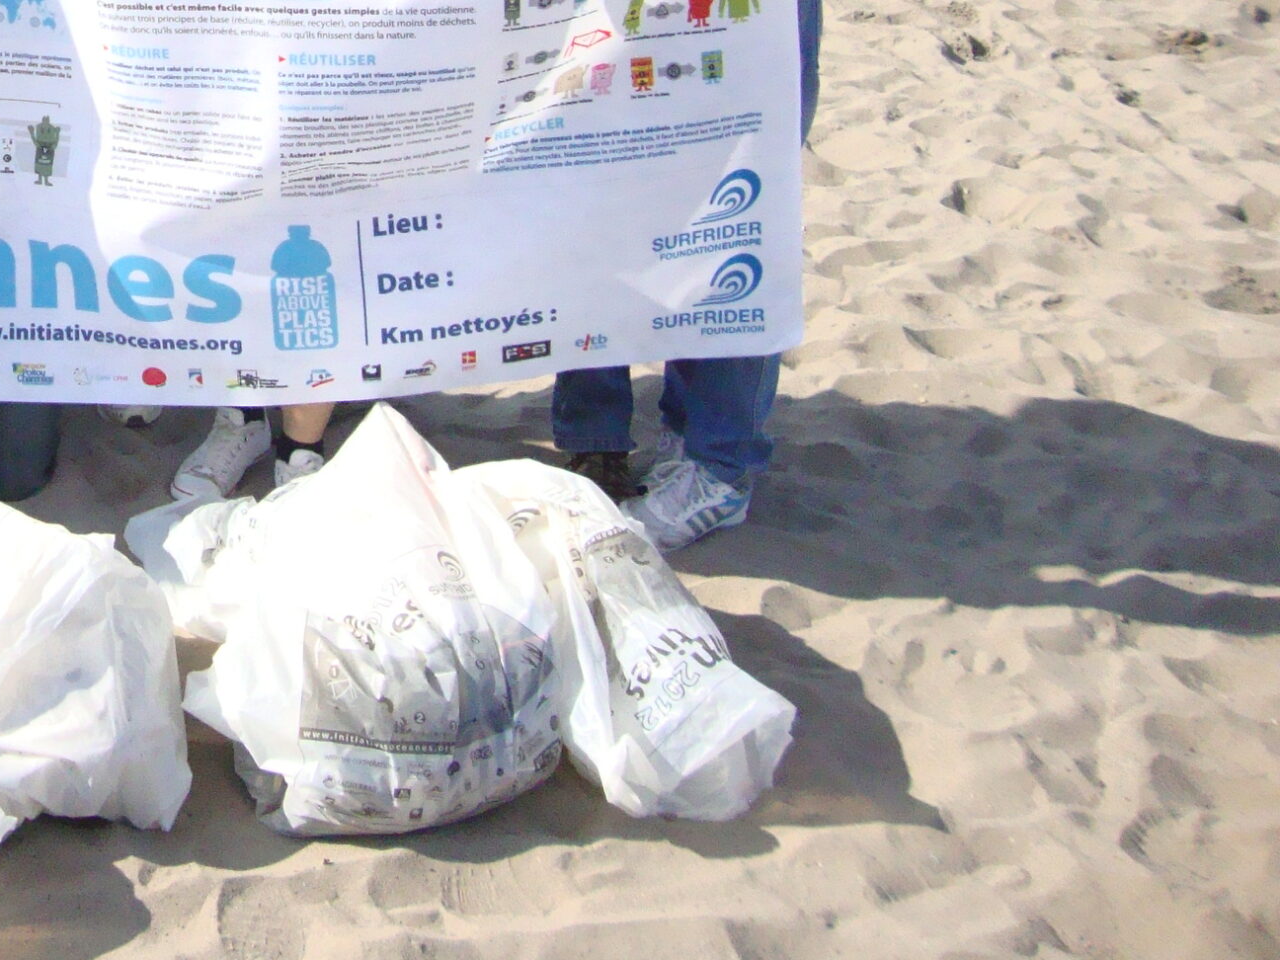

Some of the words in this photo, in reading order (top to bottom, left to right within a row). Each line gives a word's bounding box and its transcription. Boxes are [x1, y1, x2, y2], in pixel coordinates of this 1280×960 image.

[116, 2, 152, 12] possible
[166, 3, 186, 12] c'est
[188, 3, 215, 12] même
[217, 3, 242, 12] facile
[266, 6, 309, 16] quelques
[311, 8, 341, 17] gestes
[343, 8, 380, 18] simples
[382, 8, 393, 16] de
[405, 7, 418, 15] vie
[420, 5, 476, 17] quotidienne.
[137, 14, 155, 23] trois
[157, 15, 195, 26] principes
[198, 15, 207, 24] de
[210, 15, 230, 25] base
[362, 19, 394, 29] produit
[397, 19, 424, 28] moins
[426, 18, 438, 27] de
[440, 17, 476, 27] déchets.
[129, 25, 150, 34] donc
[174, 26, 199, 35] soient
[293, 31, 315, 42] qu'ils
[317, 30, 353, 40] finissent
[355, 30, 374, 40] dans
[376, 30, 384, 39] la
[386, 31, 417, 40] nature.
[111, 45, 170, 60] RÉDUIRE
[289, 52, 376, 66] RÉUTILISER
[371, 214, 429, 238] Lieu
[651, 221, 763, 253] SURFRIDER
[275, 277, 329, 295] RISE
[376, 271, 440, 296] Date
[276, 294, 329, 312] ABOVE
[277, 311, 331, 328] PLAS
[380, 325, 424, 346] Km
[427, 307, 545, 342] nettoyés
[652, 308, 765, 331] SURFRIDER
[277, 328, 334, 349] TICS
[700, 324, 766, 337] FOUNDATION
[633, 660, 702, 731] 2012
